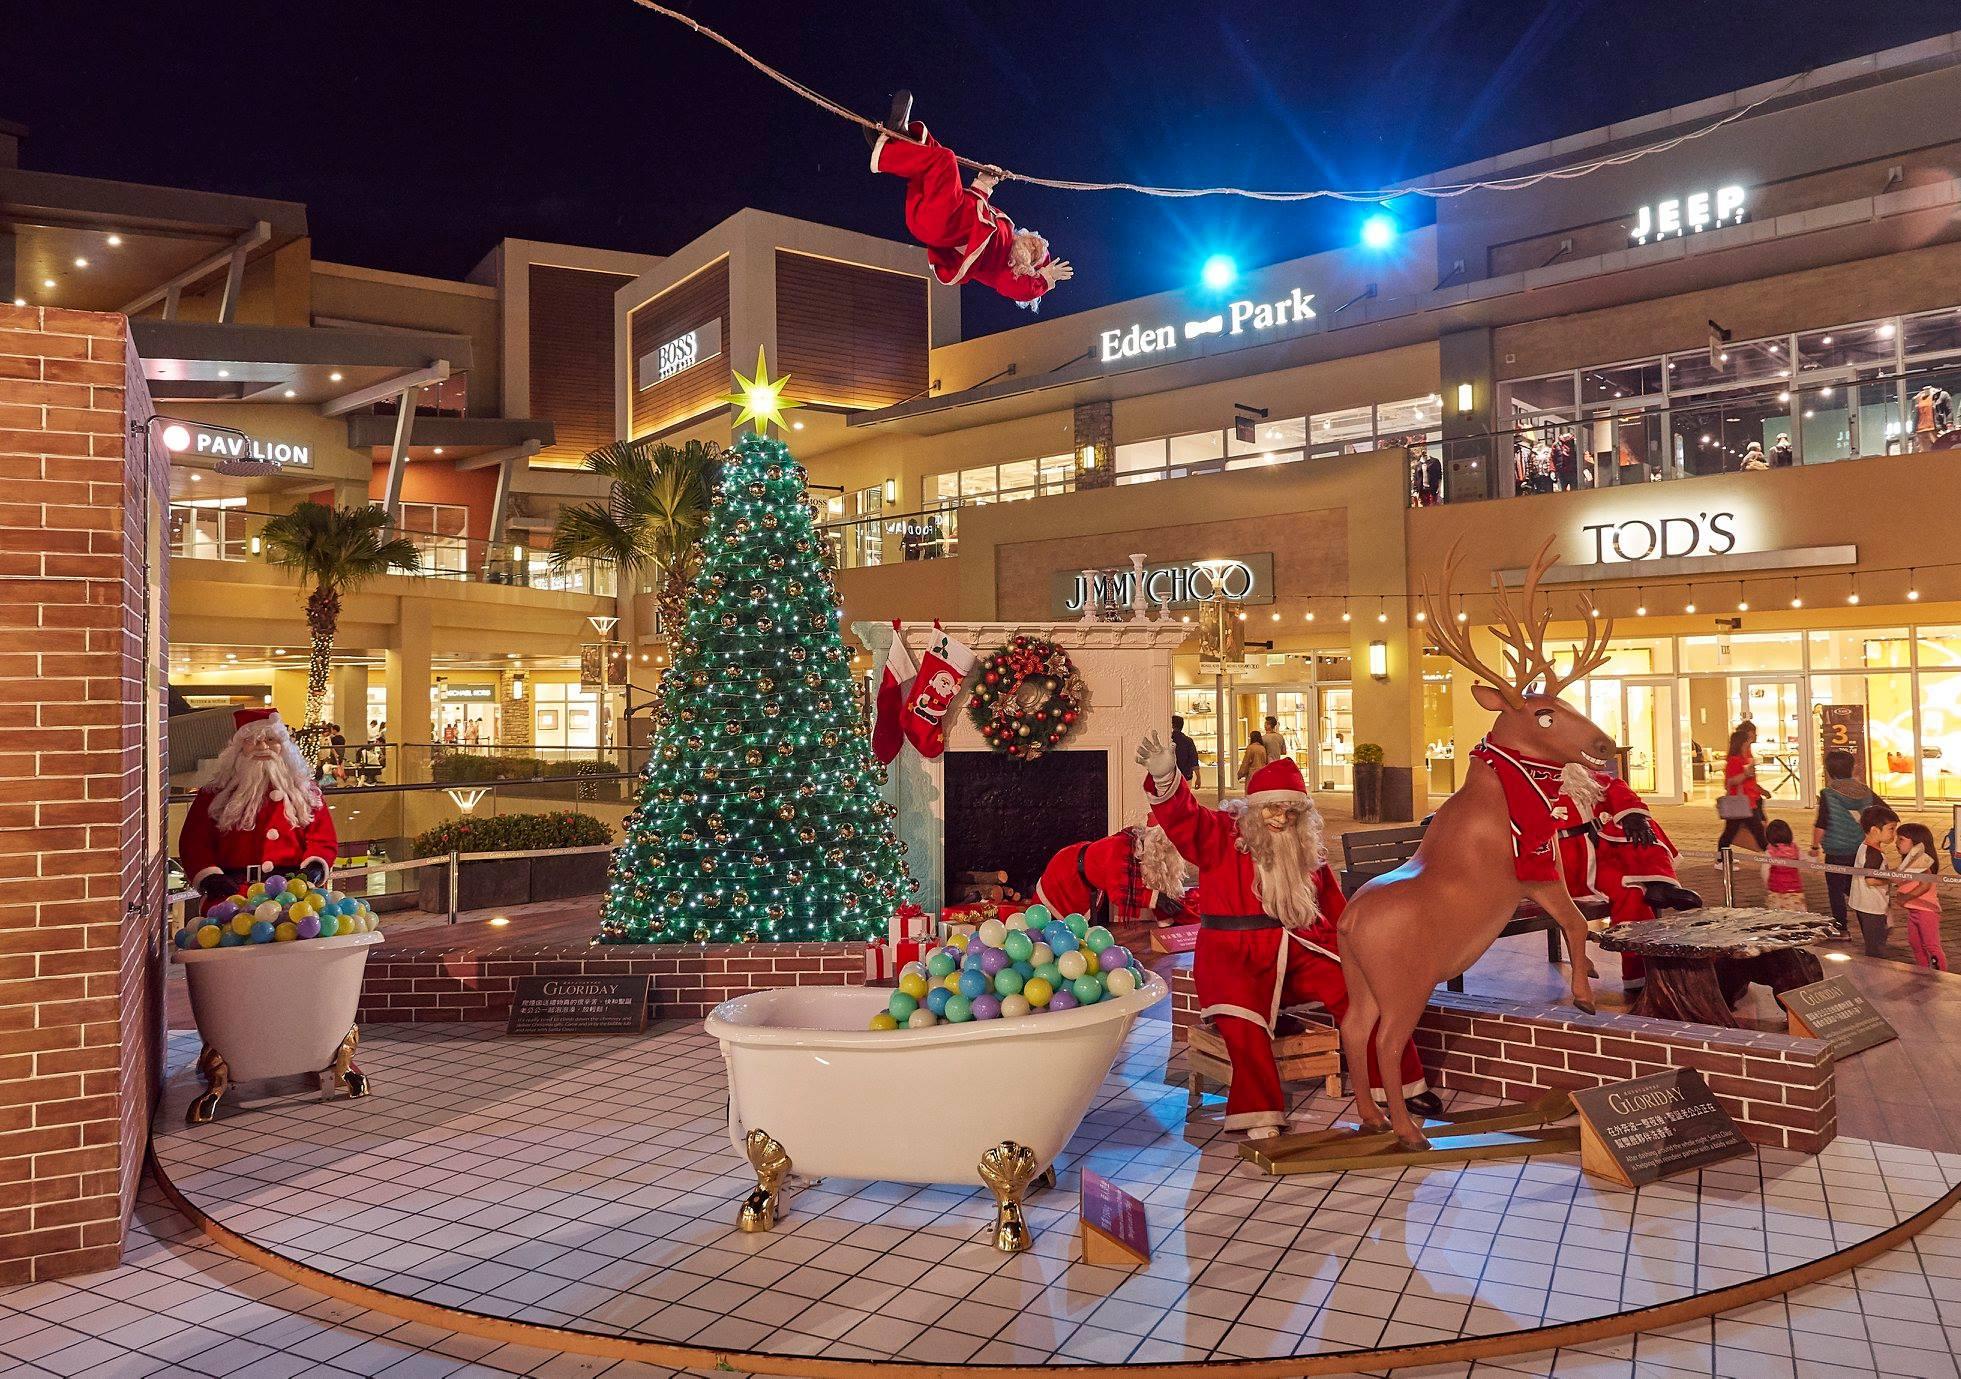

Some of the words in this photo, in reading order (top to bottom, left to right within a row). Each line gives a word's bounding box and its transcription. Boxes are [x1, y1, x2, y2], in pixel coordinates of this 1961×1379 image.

[1631, 186, 1745, 238] JEEP
[1101, 324, 1176, 361] Eden
[1229, 287, 1316, 334] Park
[658, 334, 693, 370] BOSS
[197, 434, 308, 464] PAVLION
[1583, 512, 1736, 565] TOD'S
[1832, 724, 1849, 745] 3
[1872, 870, 1891, 878] GLORIA
[543, 981, 619, 996] GLORIDAY
[1608, 1086, 1685, 1116] GLORIDAY
